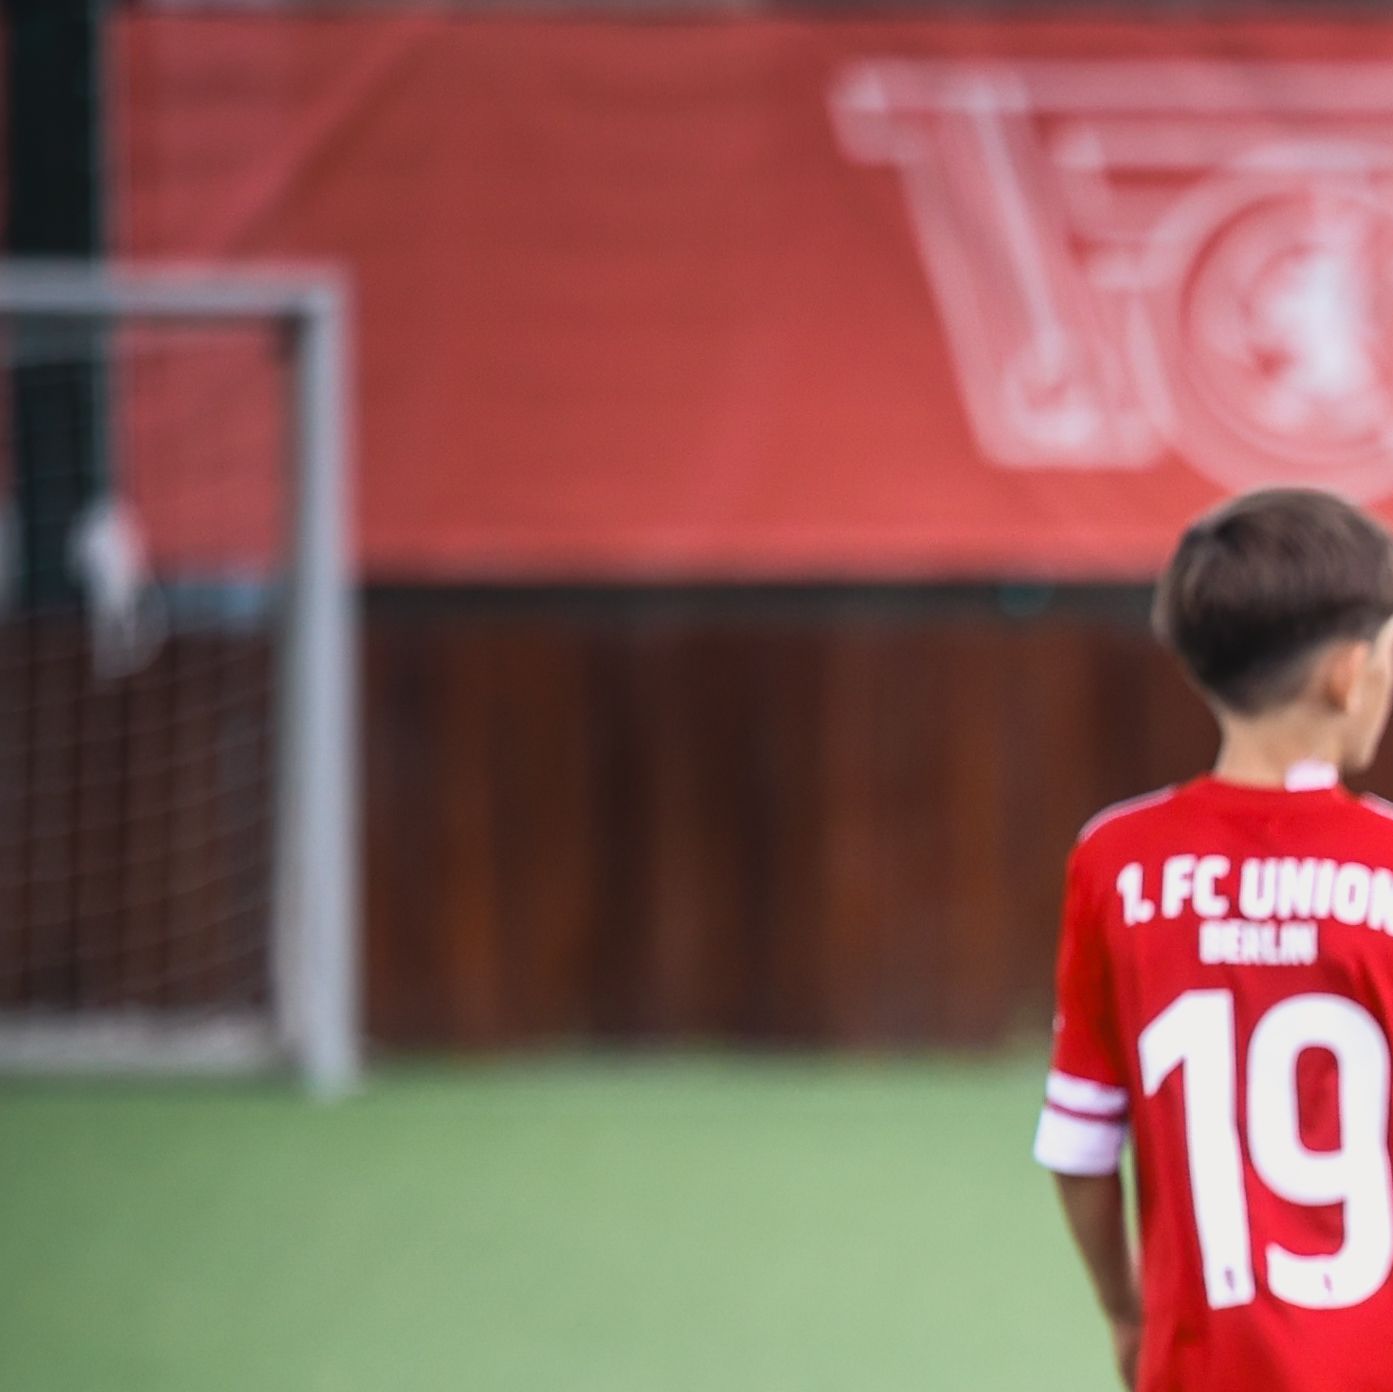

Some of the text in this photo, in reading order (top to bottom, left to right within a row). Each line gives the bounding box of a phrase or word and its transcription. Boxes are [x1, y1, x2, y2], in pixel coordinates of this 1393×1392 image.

[1116, 861, 1155, 928] 1.
[1161, 853, 1231, 920] FC
[1199, 917, 1319, 966] BERLIN
